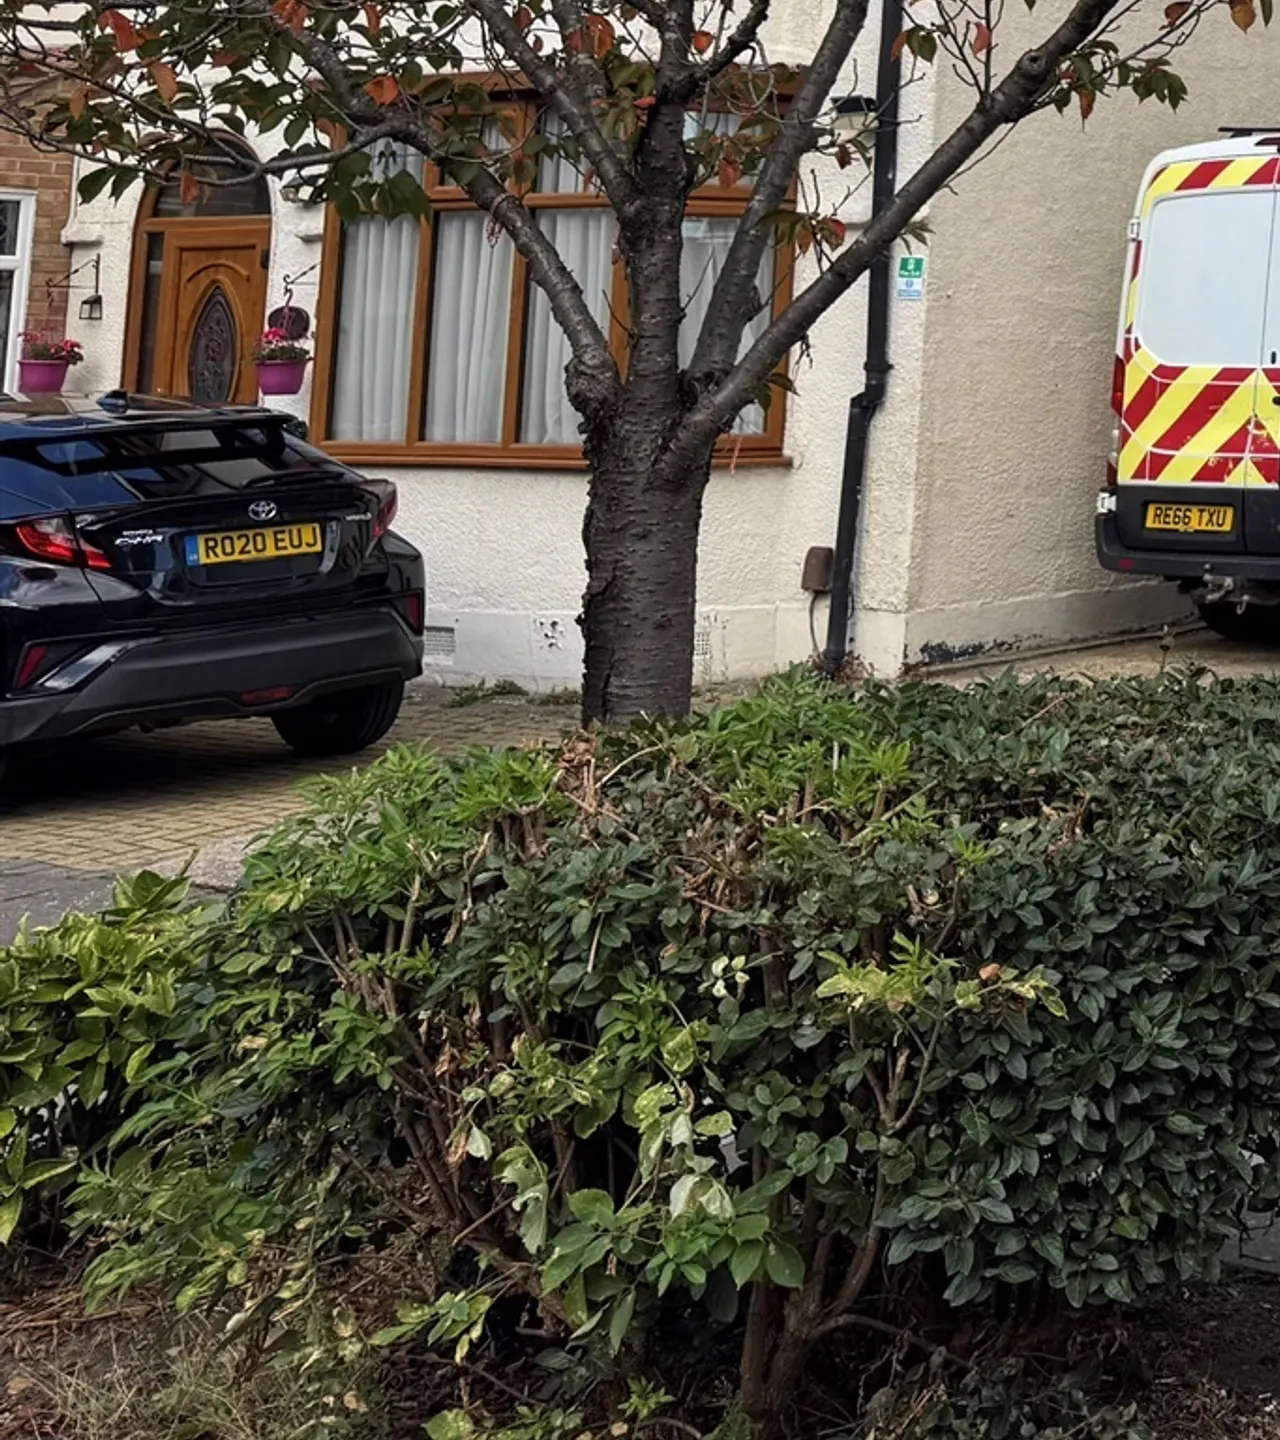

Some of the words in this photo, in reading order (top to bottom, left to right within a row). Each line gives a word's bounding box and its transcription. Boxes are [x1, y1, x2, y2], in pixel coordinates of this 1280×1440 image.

[1153, 506, 1192, 525] RE66
[1196, 508, 1227, 527] TXU
[204, 532, 267, 559] RO20
[273, 527, 318, 551] EUJ
